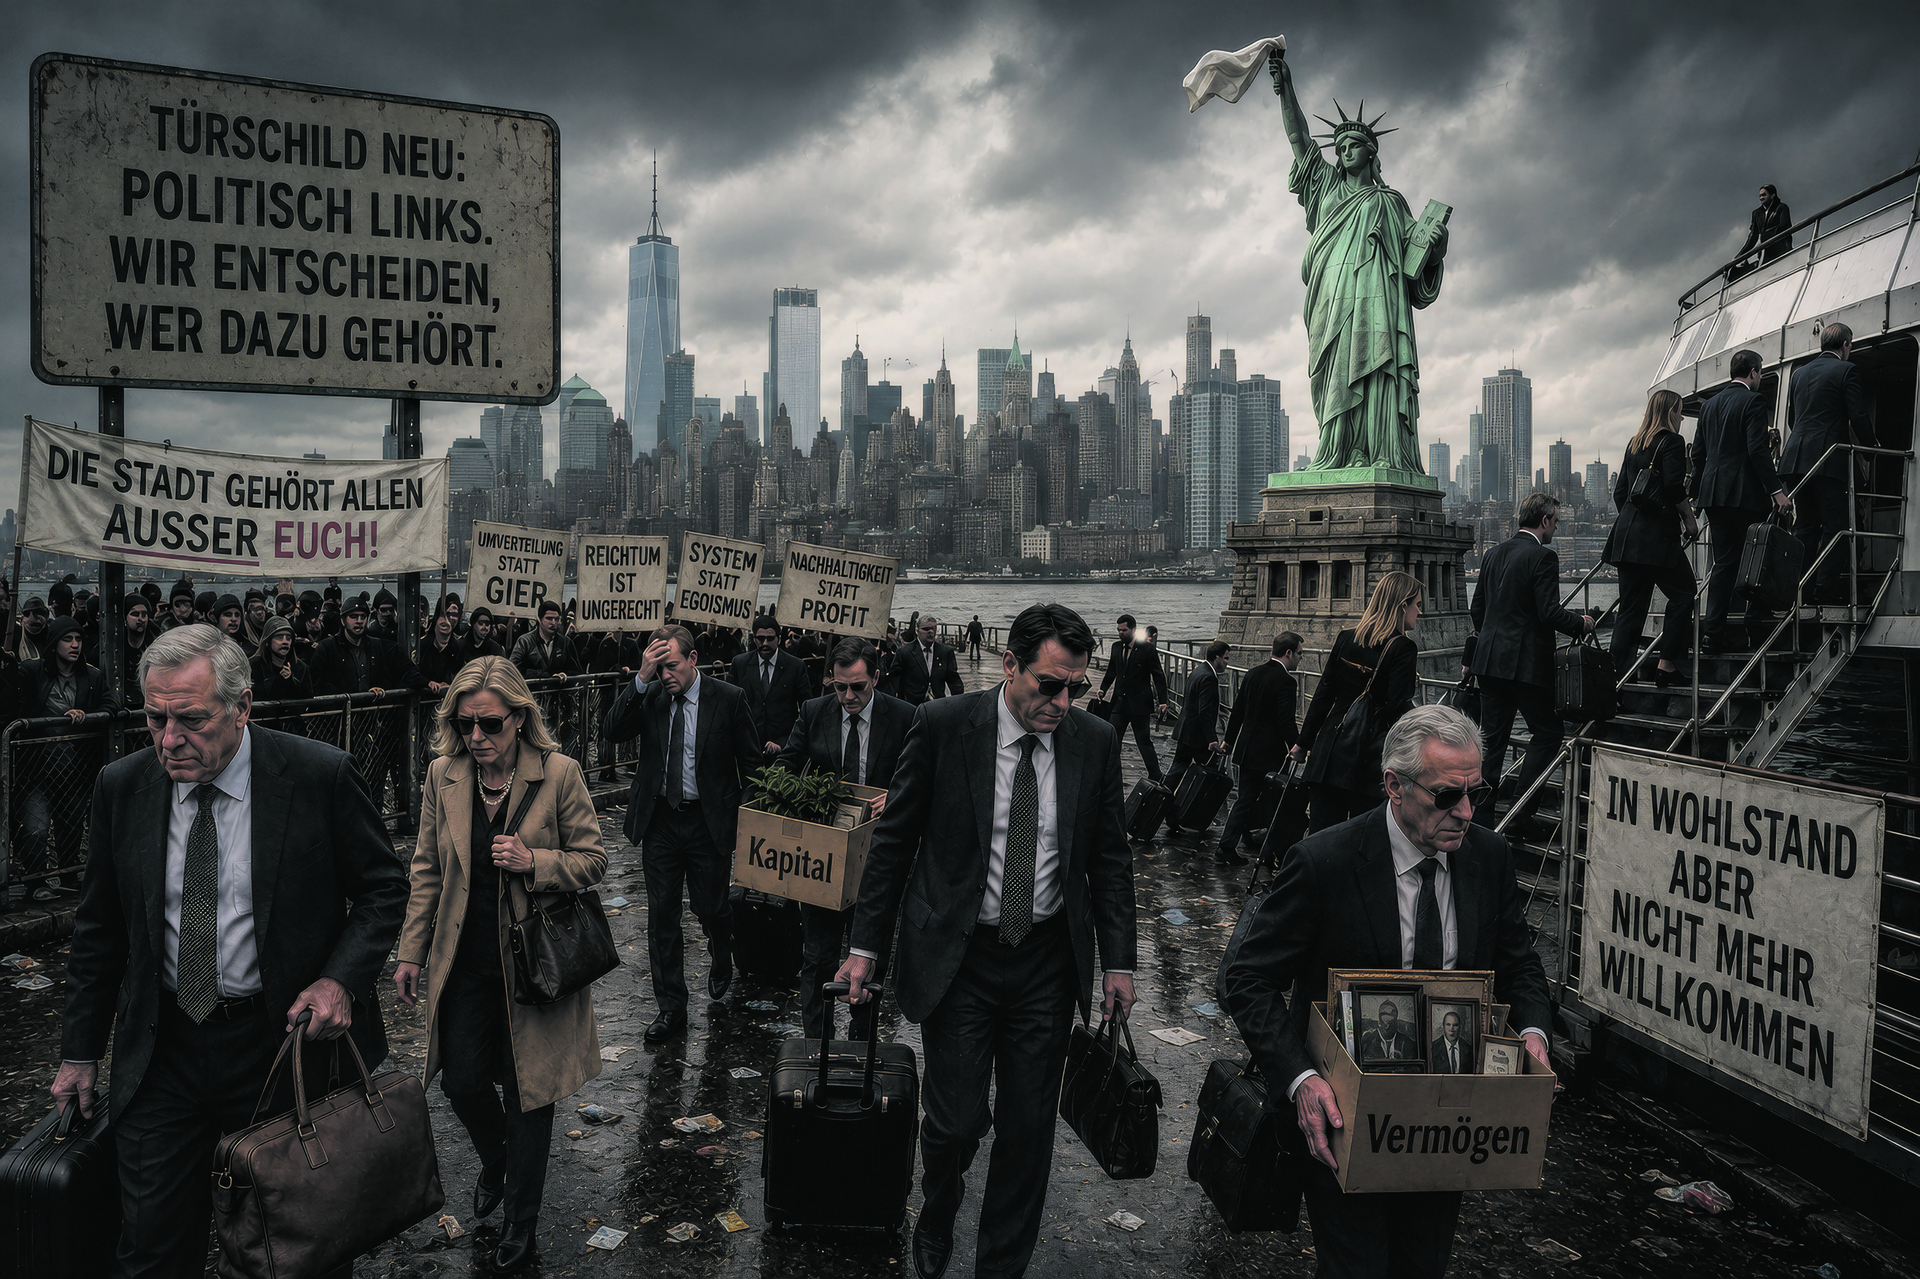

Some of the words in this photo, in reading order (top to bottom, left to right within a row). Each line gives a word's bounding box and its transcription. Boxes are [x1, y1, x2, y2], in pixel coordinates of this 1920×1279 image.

[150, 99, 367, 171] TÜRSCHILD
[383, 132, 466, 182] NEU:
[122, 167, 352, 234] POLITISCH
[371, 192, 493, 245] LINKS.
[109, 235, 196, 287] WIR
[214, 243, 500, 313] ENTSCHEIDEN,
[105, 302, 203, 353] WER
[220, 309, 327, 359] DAZU
[343, 311, 503, 368] GEHÖRT.
[47, 444, 100, 489] DIE
[113, 458, 214, 504] STADT
[225, 470, 334, 512] GEHÖRT
[341, 477, 424, 512] ALLEN
[103, 504, 259, 557] AUSSER
[274, 520, 379, 559] EUCH!
[478, 531, 563, 557] UMVERTEILUNG
[498, 555, 540, 575] STATT
[585, 544, 661, 566] REICHTUM
[689, 541, 758, 573] SYSTEM
[789, 551, 893, 585] NACHHALTIGKEIT
[486, 576, 547, 608] GIER
[609, 572, 637, 593] IST
[698, 569, 740, 591] STATT
[818, 579, 860, 600] STATT
[582, 599, 661, 620] UNGERECHT
[680, 589, 752, 619] EGOISMUS
[800, 598, 869, 628] PROFIT
[1606, 775, 1639, 826] IN
[1650, 784, 1858, 879] WOHLSTAND
[748, 835, 833, 883] Kapital
[1669, 849, 1755, 920] ABER
[1611, 889, 1704, 964] NICHT
[1716, 923, 1815, 1007] MEHR
[1599, 940, 1835, 1089] WILLKOMMEN
[1367, 1113, 1530, 1165] Vermögen
